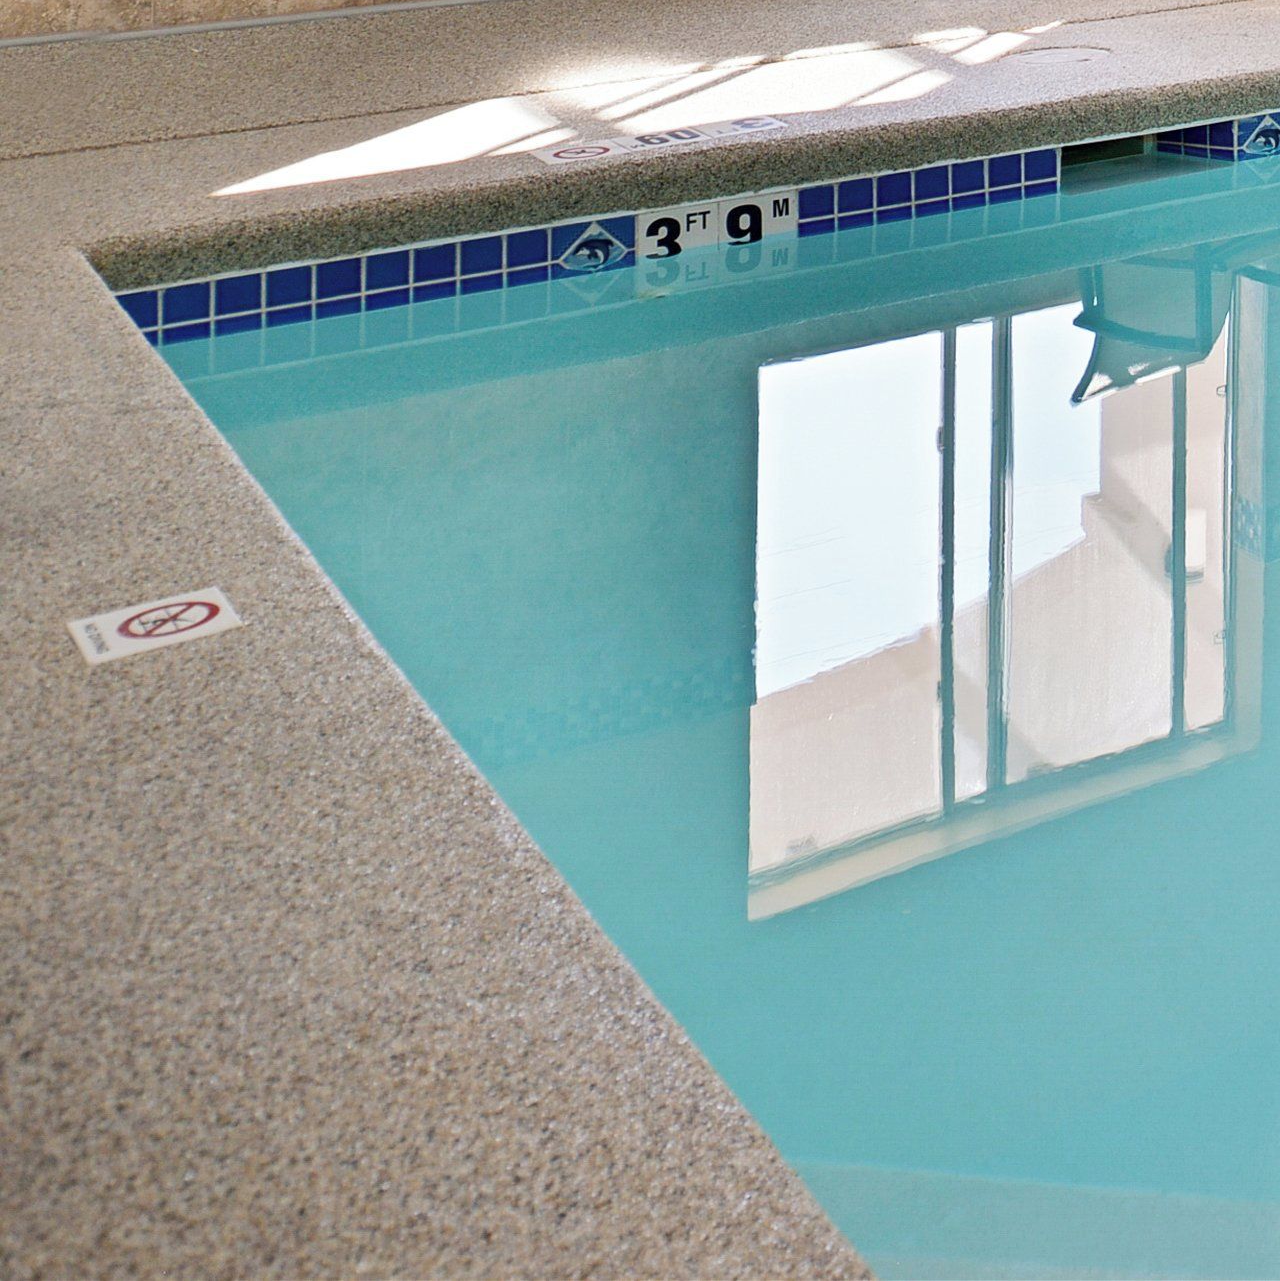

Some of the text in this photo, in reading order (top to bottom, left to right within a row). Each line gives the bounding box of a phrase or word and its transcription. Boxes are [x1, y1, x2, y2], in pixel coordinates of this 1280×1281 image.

[645, 197, 790, 259] 3 FT 9 M
